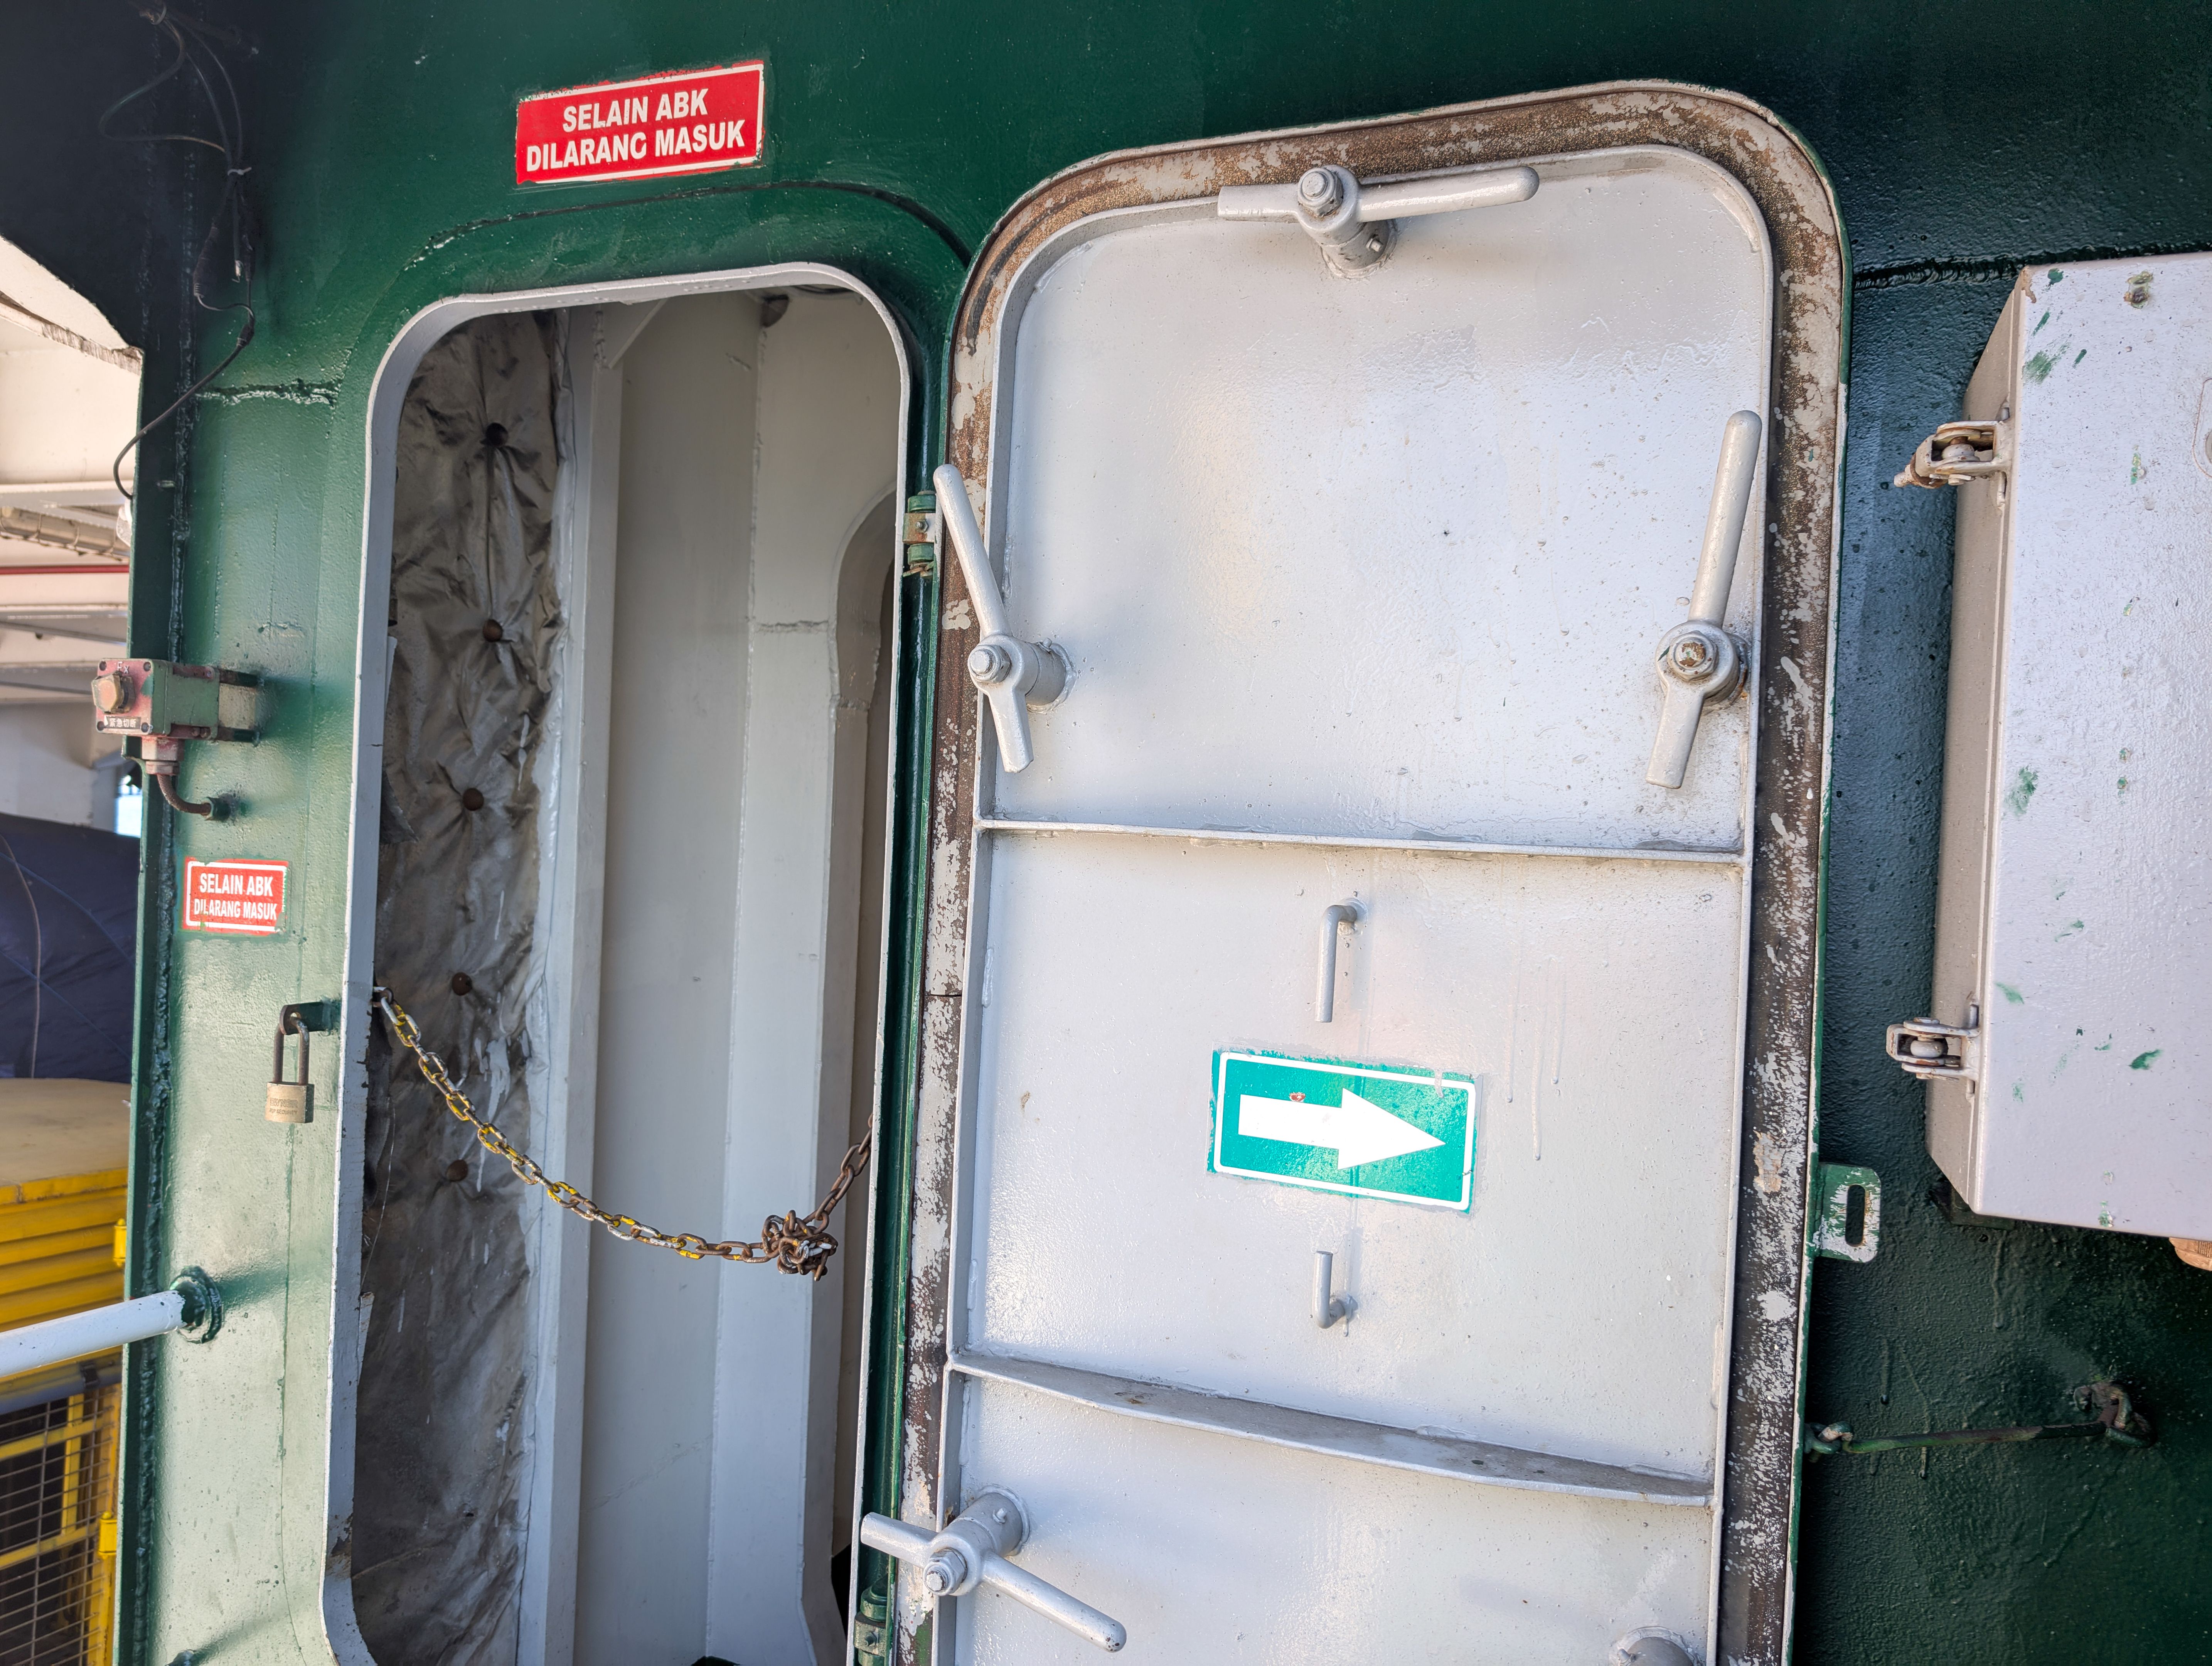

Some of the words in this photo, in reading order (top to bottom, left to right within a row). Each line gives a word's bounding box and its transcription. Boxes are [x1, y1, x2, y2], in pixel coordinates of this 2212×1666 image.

[563, 96, 648, 132] SELAIN
[655, 88, 708, 120] ABK
[527, 132, 647, 172] DILARANG
[655, 120, 745, 157] MASUK
[200, 873, 243, 895] SELAIN
[247, 875, 273, 897] ABK
[194, 898, 241, 918] DILARANG
[243, 902, 277, 920] MASUK
[270, 1098, 298, 1108] OWNER
